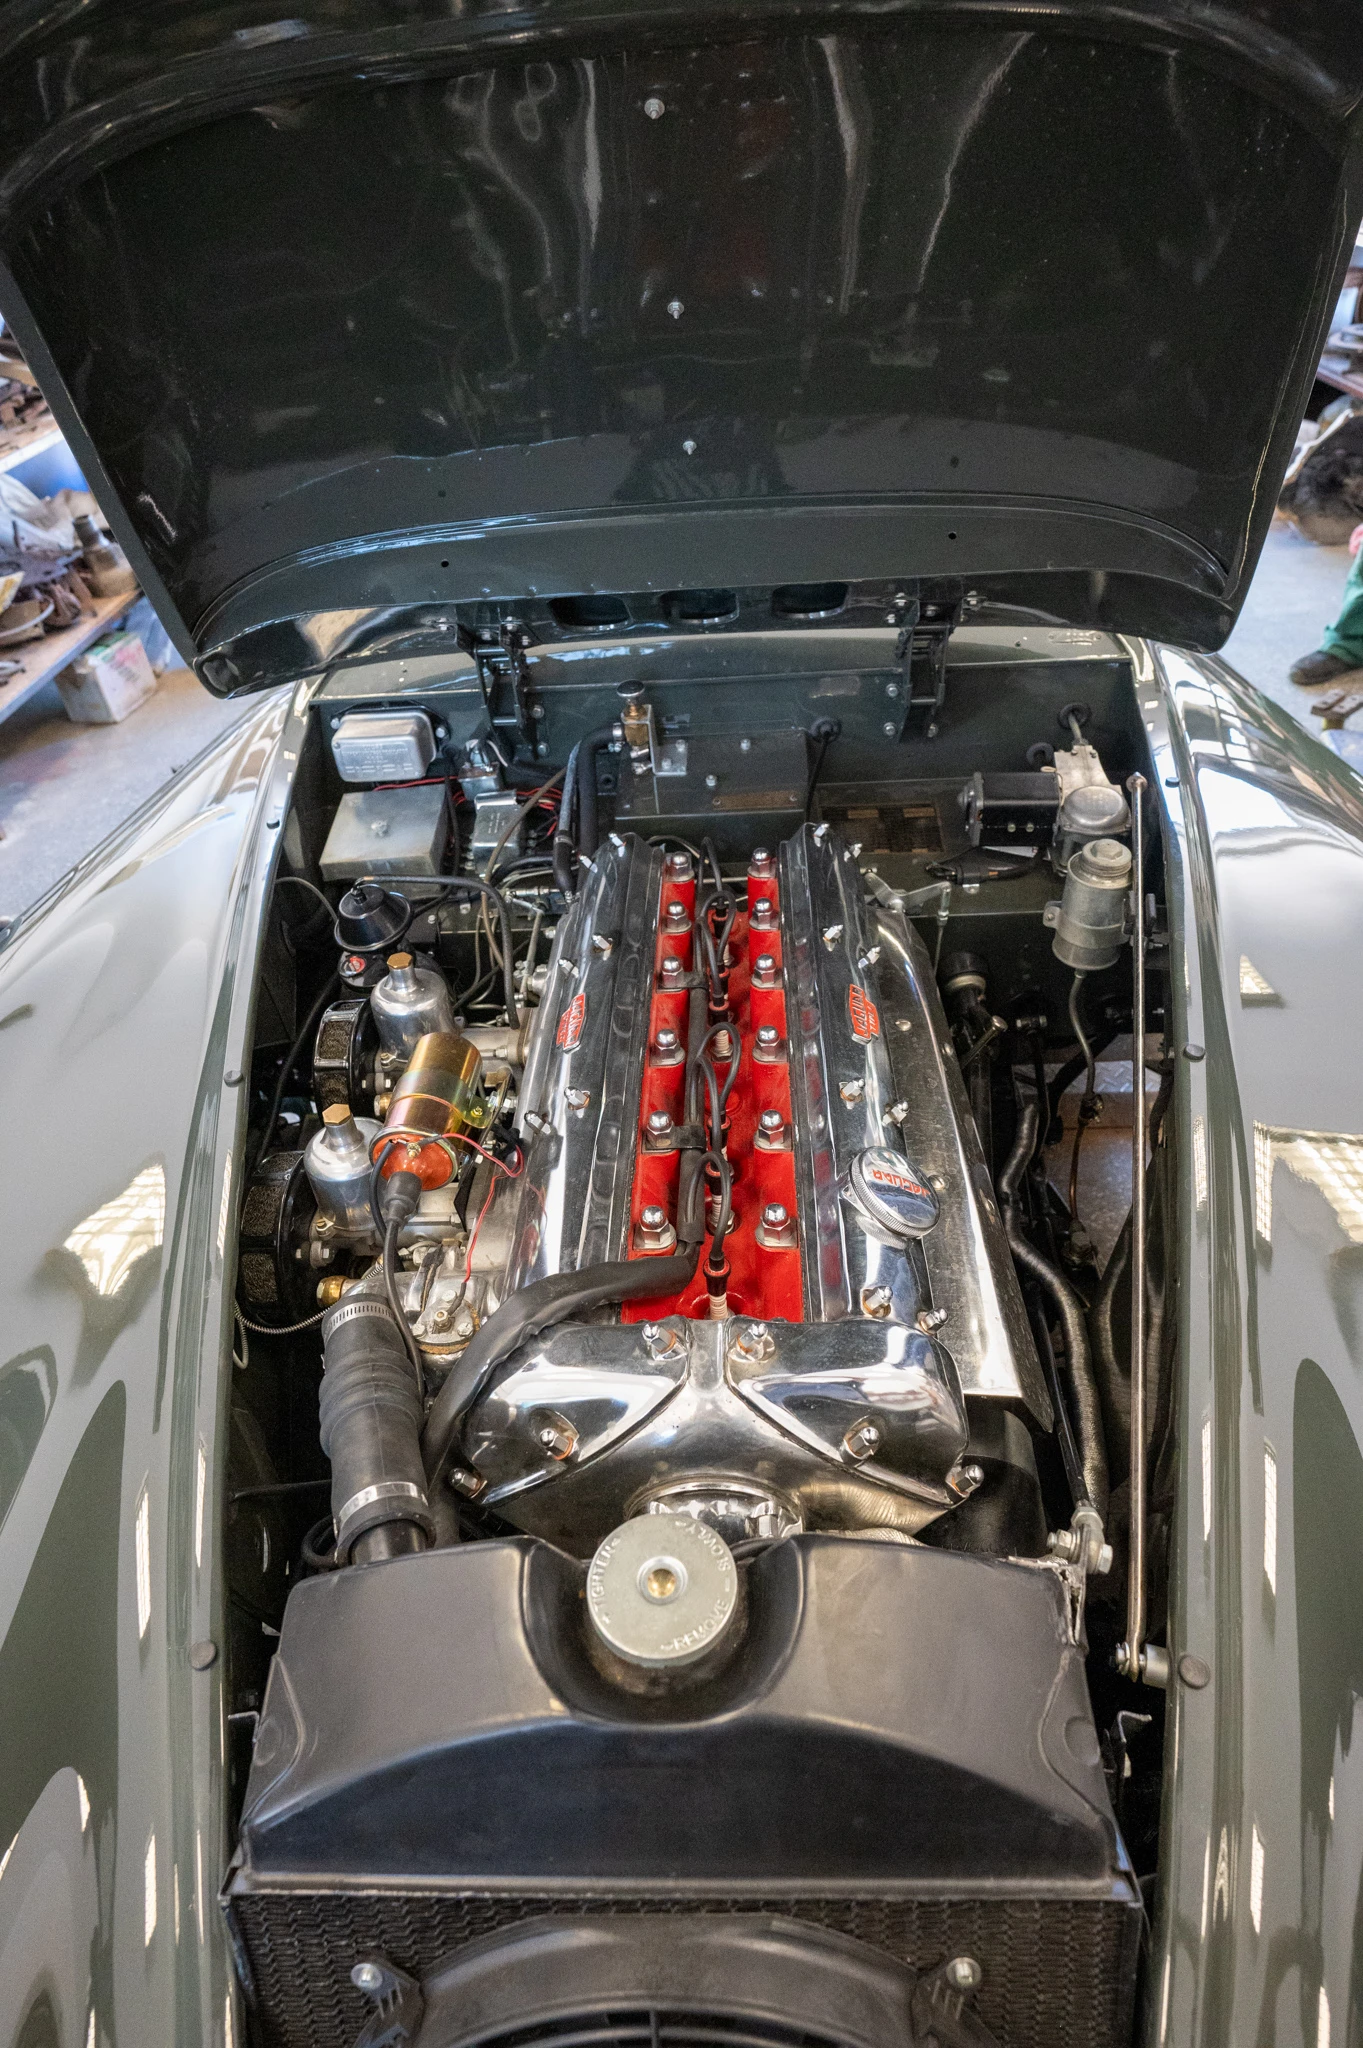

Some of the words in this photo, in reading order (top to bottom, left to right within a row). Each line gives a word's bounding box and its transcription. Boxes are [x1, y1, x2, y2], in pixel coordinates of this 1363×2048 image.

[852, 987, 868, 1037] JAGUAR
[873, 1168, 931, 1197] JAGUAR
[686, 1524, 731, 1572] SLOWLY
[591, 1545, 615, 1612] TIGHTEN
[674, 1599, 729, 1650] REMOVE
